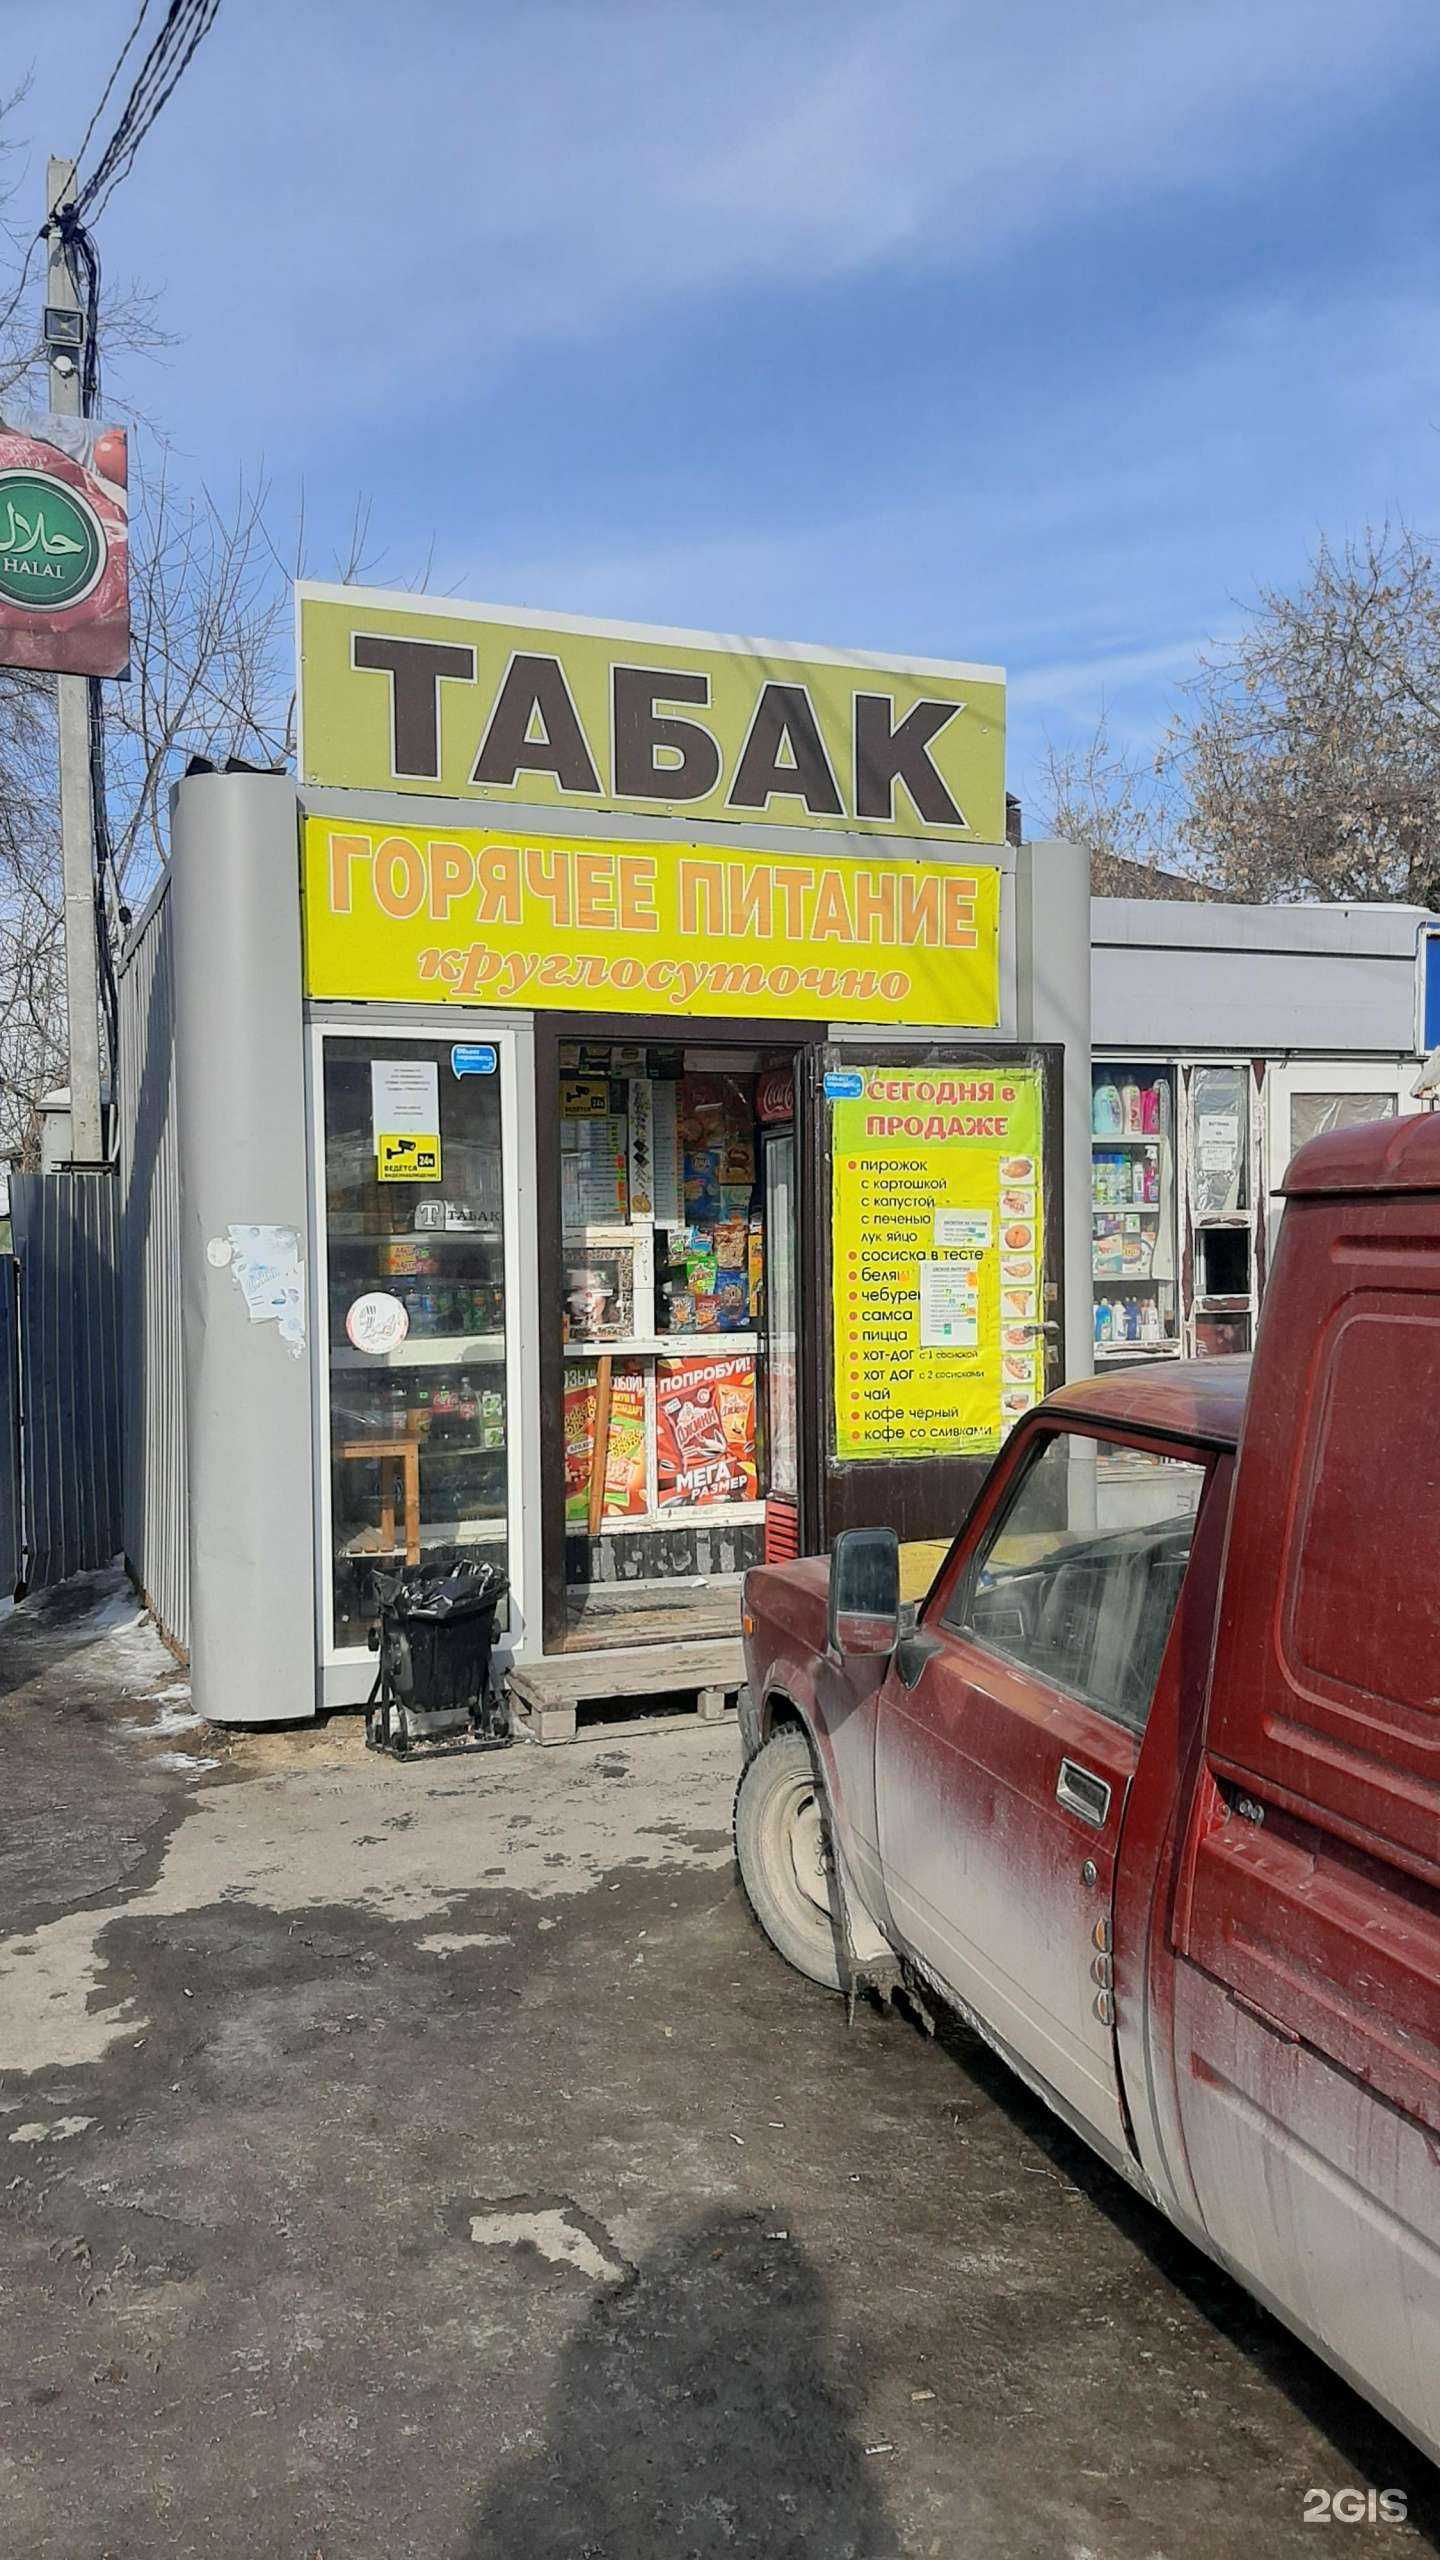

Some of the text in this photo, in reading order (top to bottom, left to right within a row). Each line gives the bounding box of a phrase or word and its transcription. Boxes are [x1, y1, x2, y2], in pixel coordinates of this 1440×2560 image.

[3, 557, 66, 580] HALAL
[350, 630, 970, 829] ТАБАК
[328, 832, 979, 948] ГОРЯЧЕЕ ПИТАНИЕ
[418, 942, 911, 1004] круглосуточно
[866, 1081, 995, 1104] СЕГОДНЯ
[866, 1115, 1009, 1141] ПРОДАЖЕ
[861, 1161, 927, 1174] пирожок
[861, 1178, 946, 1192] с картошкой
[861, 1196, 934, 1210] с капустой
[861, 1215, 930, 1224] с печенью
[861, 1232, 917, 1244] лук яйцо
[862, 1251, 926, 1261] сосиска
[944, 1250, 984, 1260] тесте
[862, 1311, 912, 1321] самса
[863, 1331, 907, 1342] пицца
[863, 1350, 915, 1362] хот-дог
[659, 1357, 751, 1394] ПОПРОБУЙ!
[864, 1369, 885, 1380] хот
[889, 1369, 915, 1381] дог
[864, 1388, 890, 1400] чай
[865, 1406, 904, 1422] кофе
[864, 1425, 992, 1442] кофе со сливками
[675, 1461, 732, 1493] МЕГА
[690, 1475, 748, 1500] РАЗМЕР
